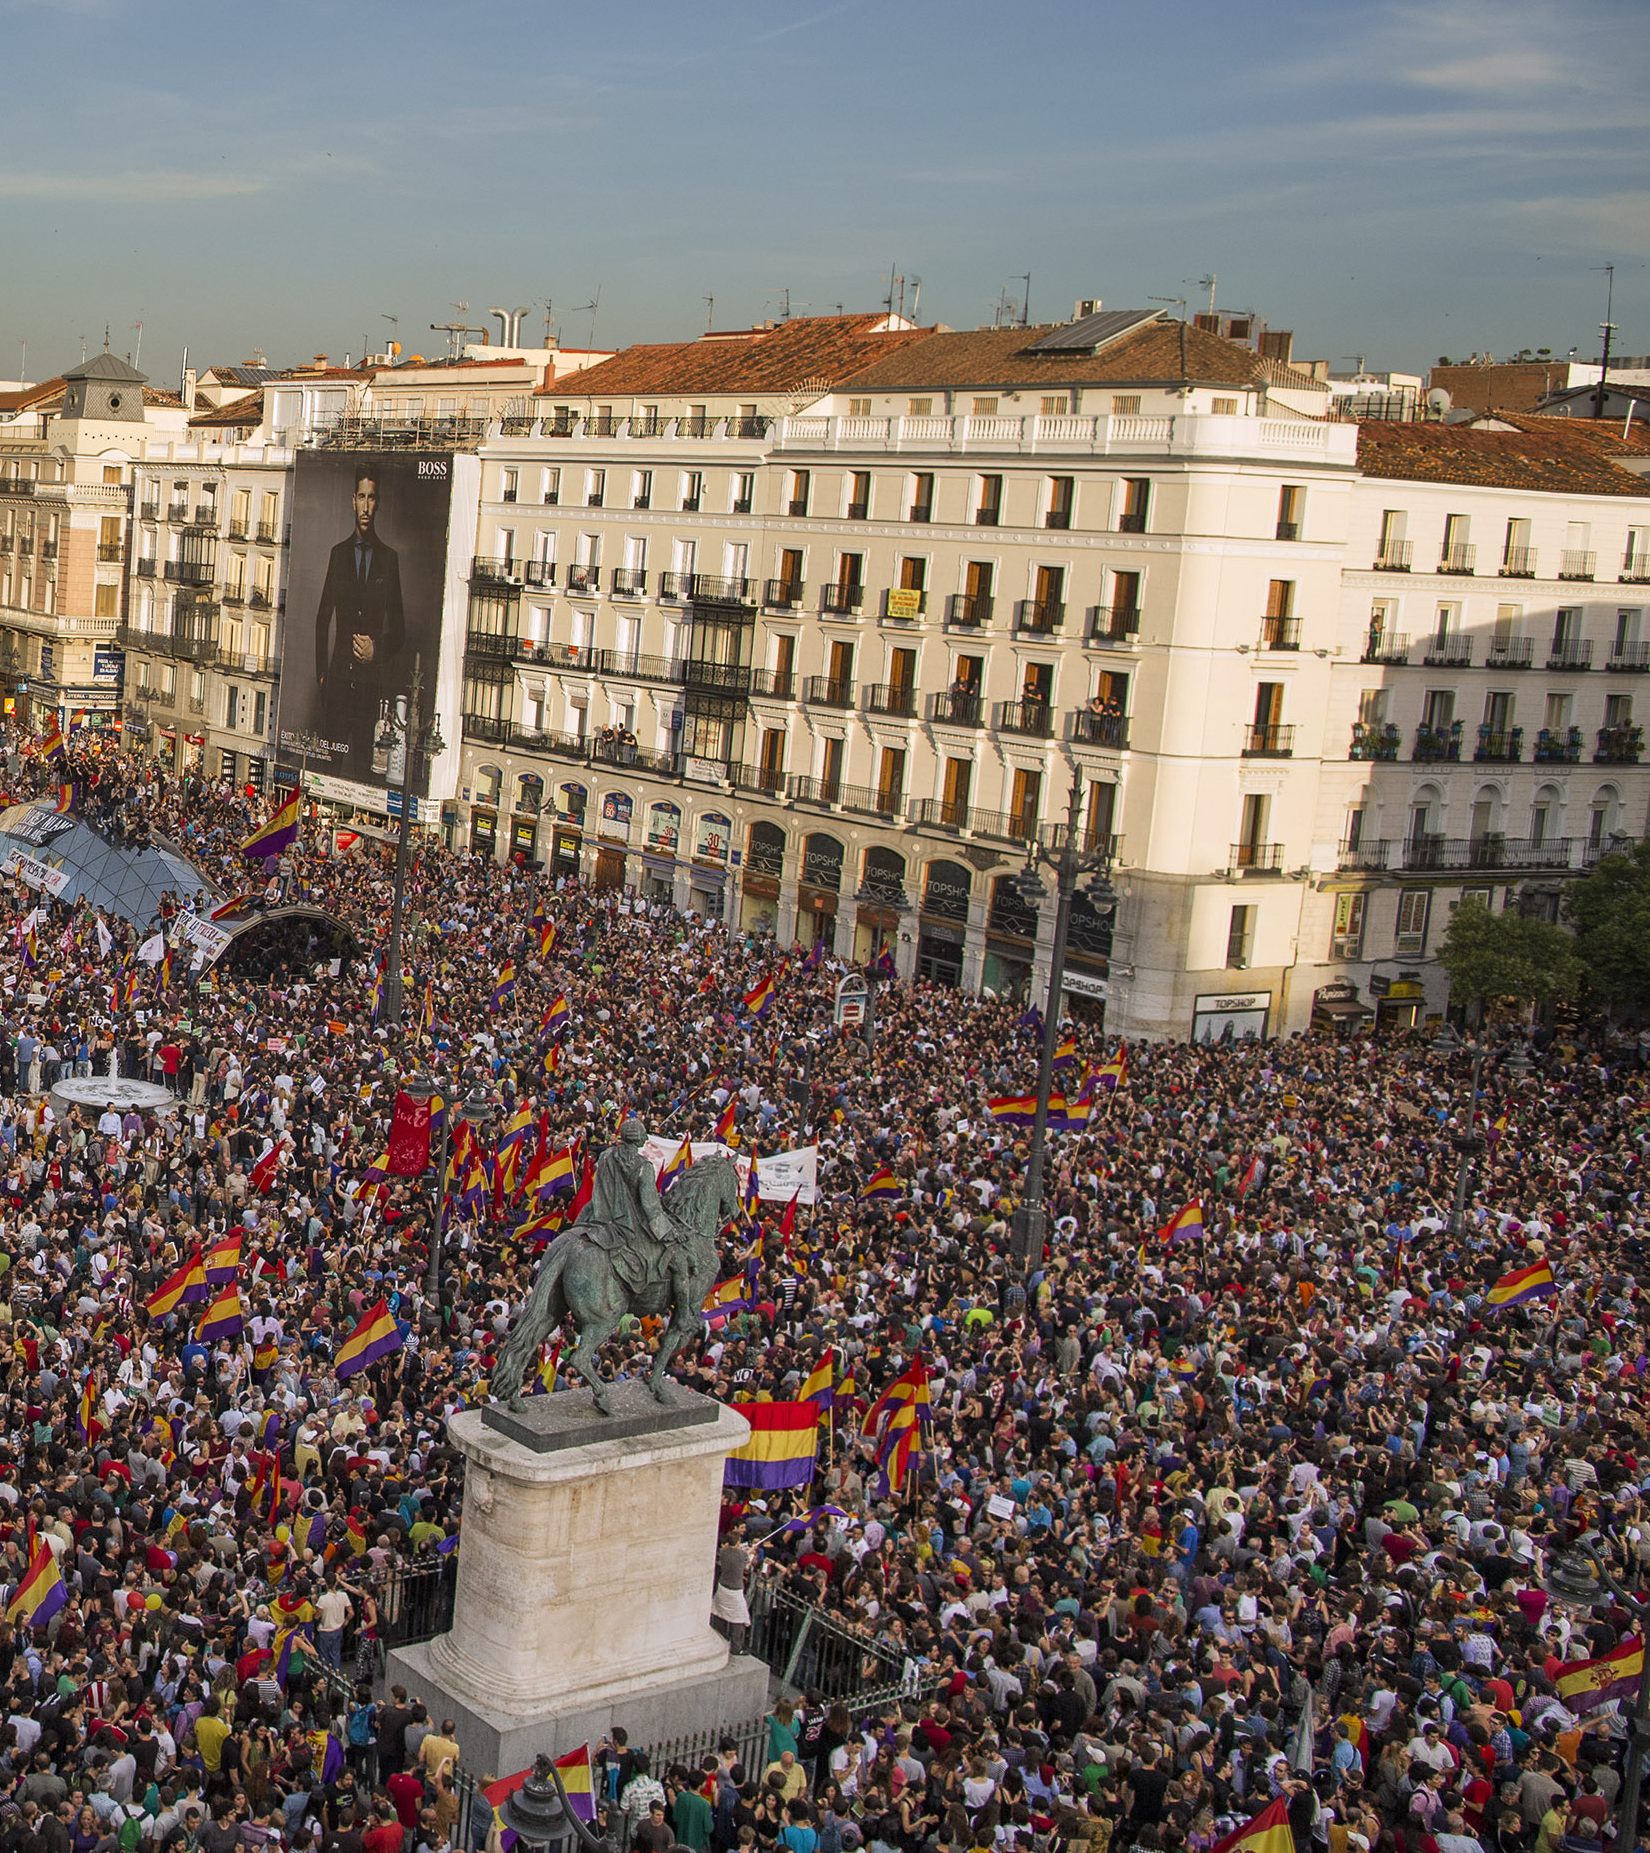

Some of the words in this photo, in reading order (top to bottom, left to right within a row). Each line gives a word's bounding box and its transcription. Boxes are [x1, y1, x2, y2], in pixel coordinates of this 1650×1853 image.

[418, 461, 447, 475] BOSS
[320, 739, 330, 749] DEL
[331, 742, 349, 753] JUEGO
[705, 832, 720, 848] -30
[751, 840, 782, 855] TOPSHO
[806, 852, 841, 867] TOPSHO
[866, 866, 901, 882] TOPSHO
[927, 880, 968, 898] TOPSHO
[1062, 976, 1103, 994] OPSHOP
[1214, 998, 1255, 1008] TOPSHOP
[90, 1016, 104, 1026] NO
[734, 1369, 752, 1381] NO
